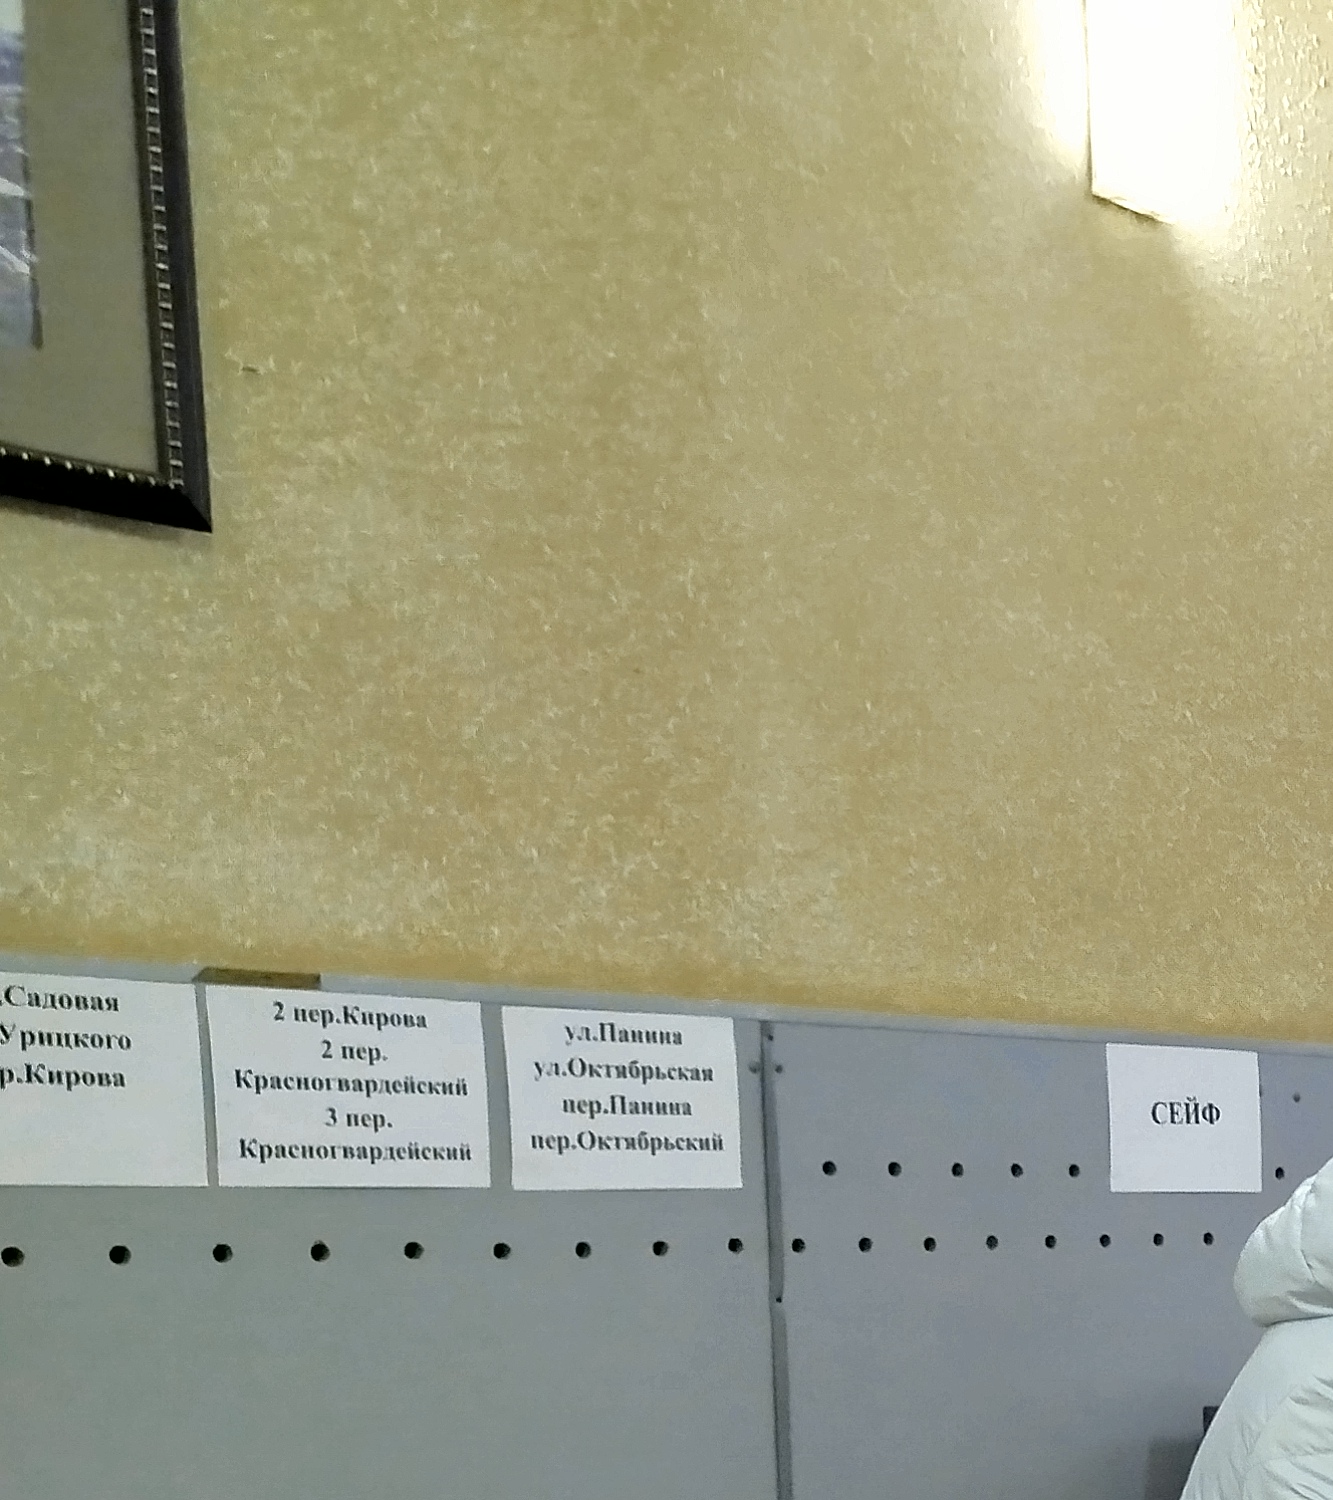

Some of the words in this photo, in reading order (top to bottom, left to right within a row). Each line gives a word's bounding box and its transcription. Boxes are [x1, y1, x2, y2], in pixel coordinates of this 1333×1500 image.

[272, 1001, 285, 1022] 2
[293, 1005, 427, 1030] пер.Кирова
[565, 1022, 683, 1046] ул.Панина
[321, 1040, 333, 1059] 2
[341, 1045, 389, 1066] пер.
[234, 1068, 468, 1096] Красногвардейский
[533, 1057, 714, 1085] ул.Октябрьская
[325, 1107, 337, 1127] 3
[346, 1113, 393, 1133] пер.
[562, 1095, 693, 1119] пер.Панина
[1151, 1096, 1221, 1126] СЕЙФ
[239, 1138, 472, 1165] Красногвардейский
[530, 1131, 725, 1157] пер.Октябрьский
